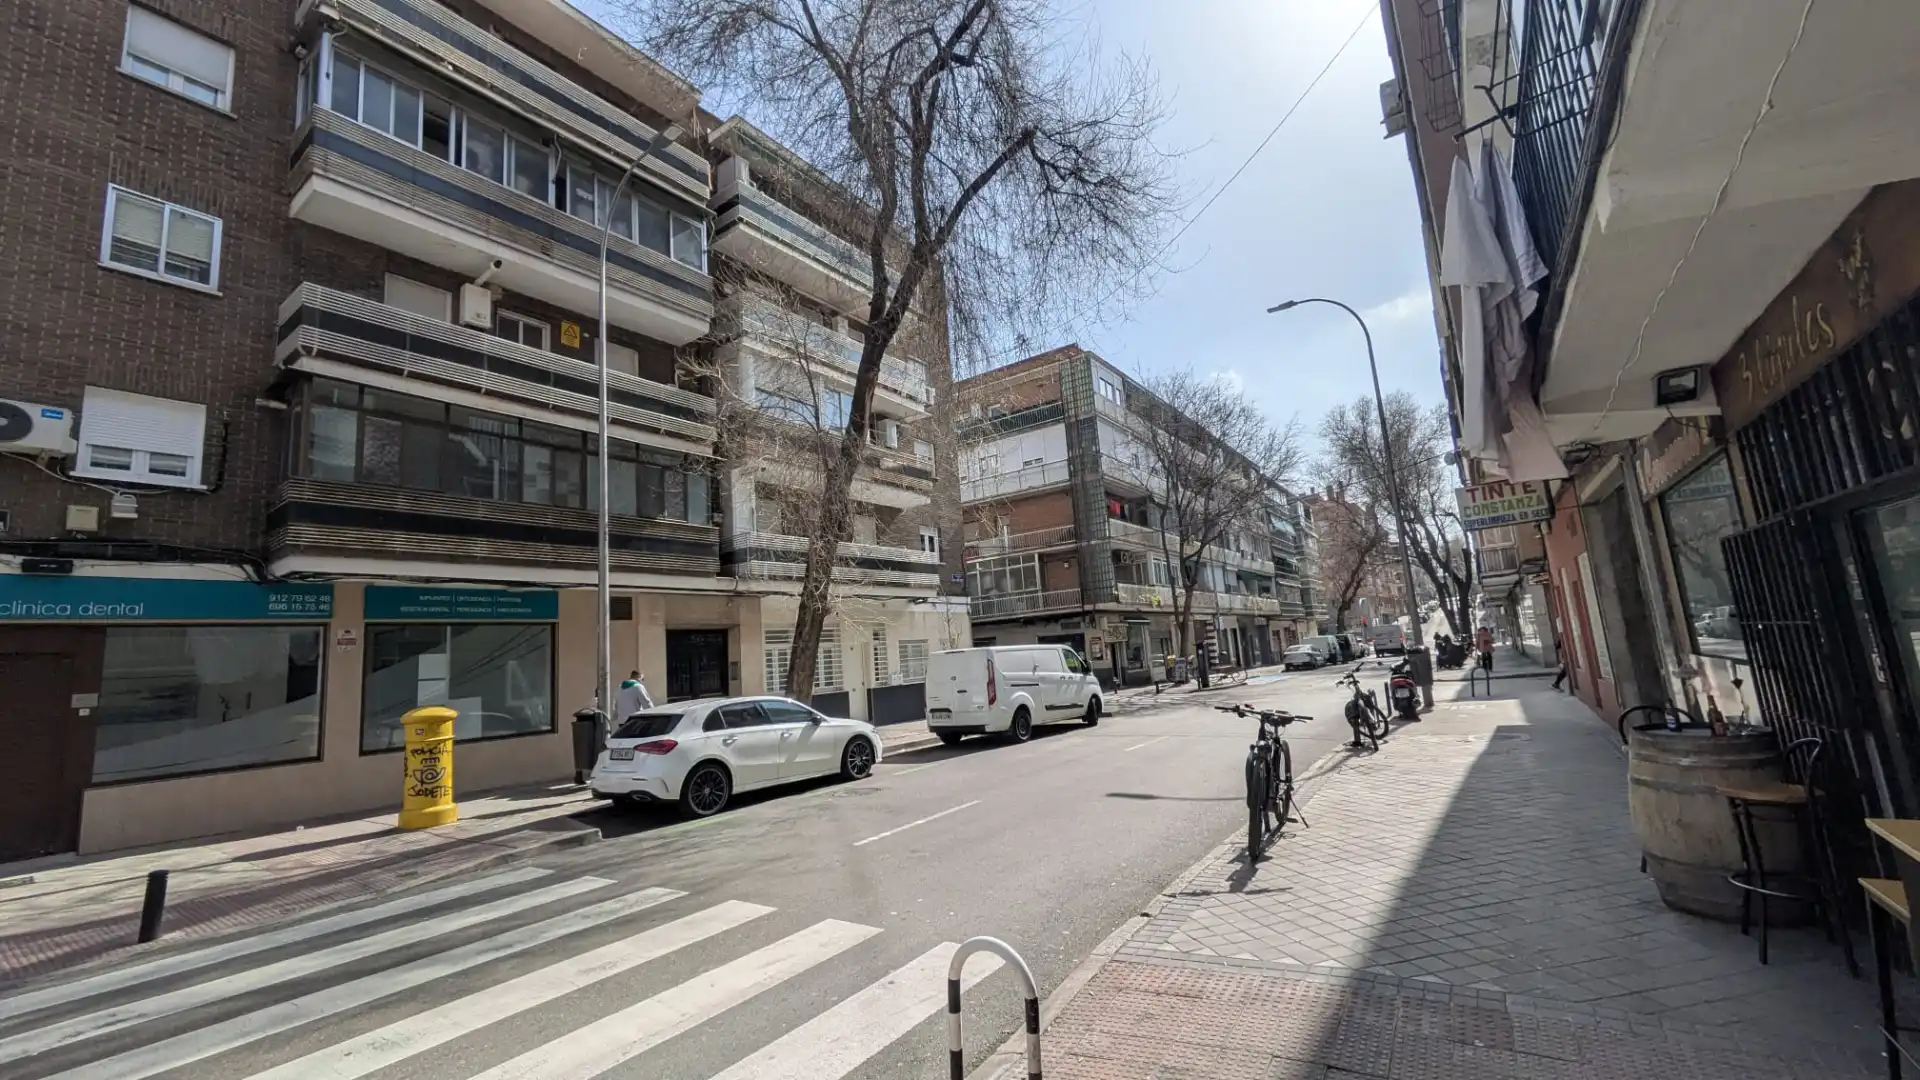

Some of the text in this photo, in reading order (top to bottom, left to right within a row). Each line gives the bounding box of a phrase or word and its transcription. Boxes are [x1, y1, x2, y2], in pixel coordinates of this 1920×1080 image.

[1737, 352, 1754, 402] 3
[1465, 481, 1537, 503] TINTE
[1464, 495, 1545, 518] CONSTANZA
[79, 601, 144, 616] dental
